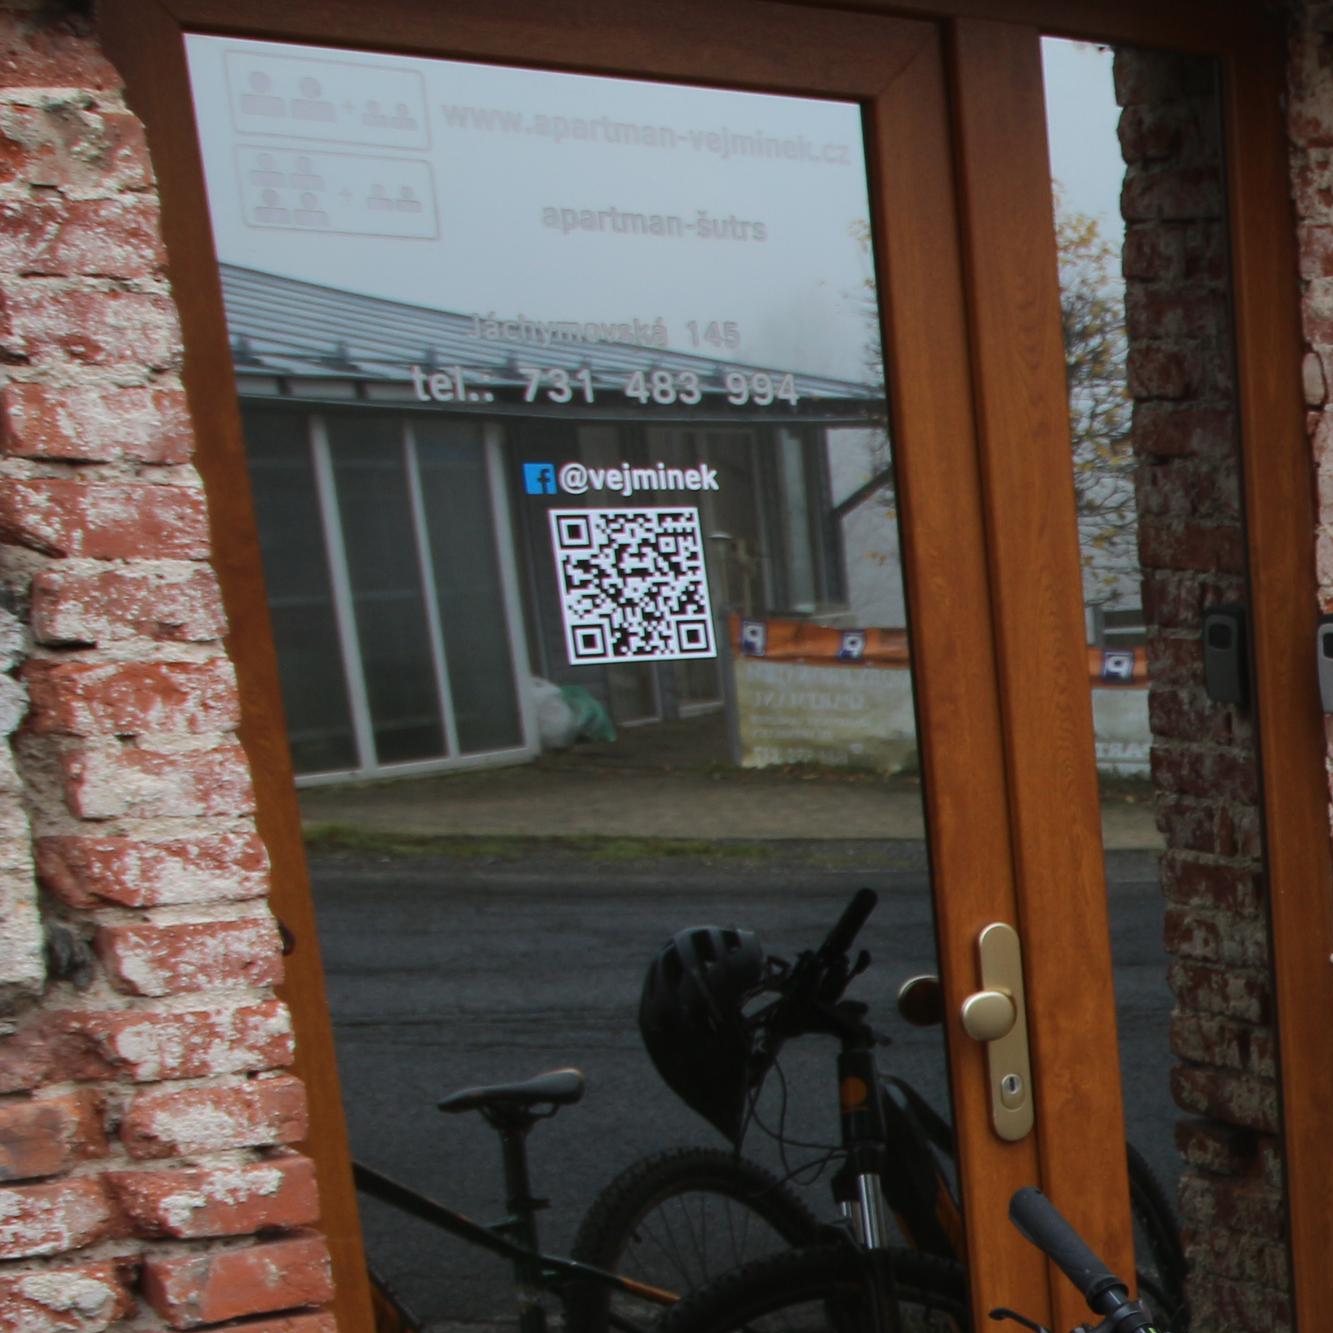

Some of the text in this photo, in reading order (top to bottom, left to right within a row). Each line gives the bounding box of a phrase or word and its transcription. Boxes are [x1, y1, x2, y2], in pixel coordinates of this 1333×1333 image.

[440, 104, 851, 165] www.apartman-vejminek.cz
[542, 206, 767, 242] apartman-šutrs
[467, 312, 741, 349] Jáchymovská 145
[411, 365, 799, 406] tel.: 731 483 994
[559, 462, 720, 496] @vejminek
